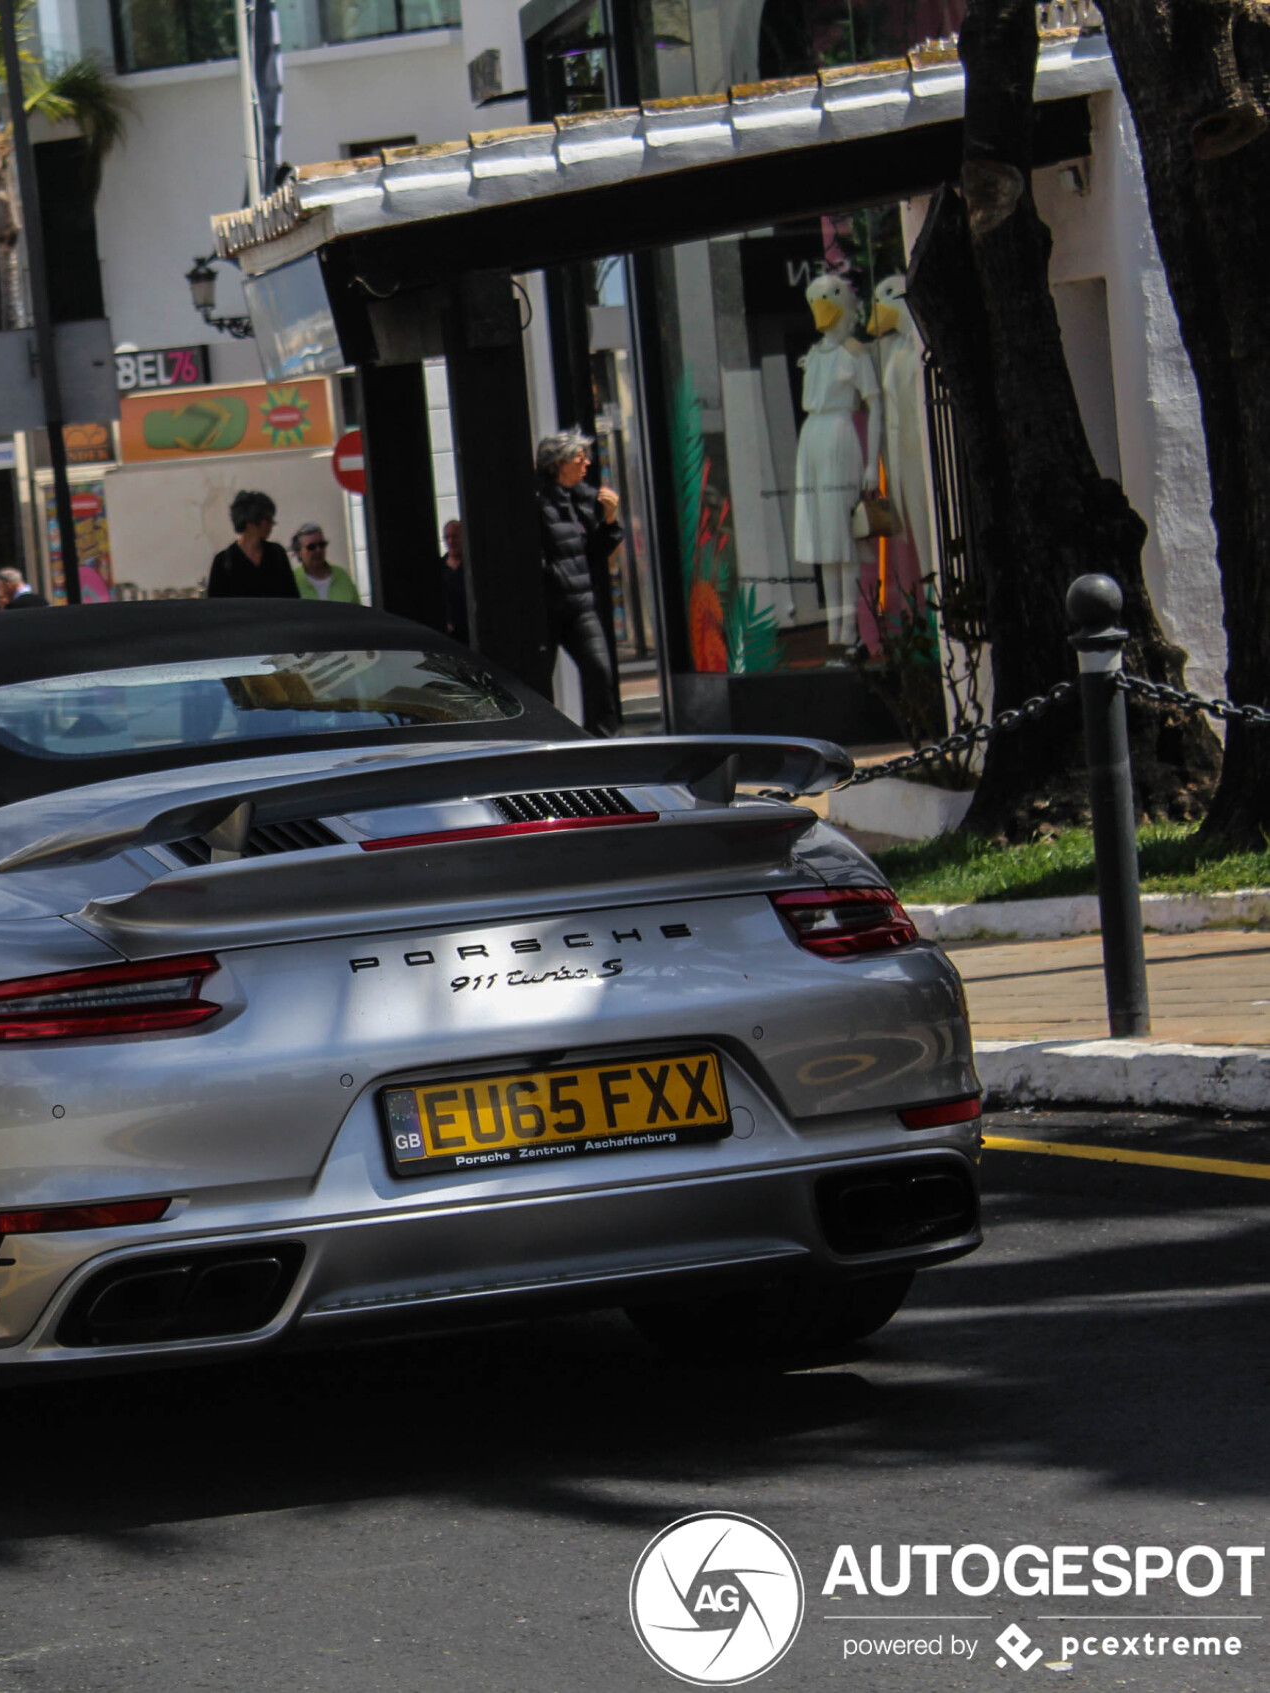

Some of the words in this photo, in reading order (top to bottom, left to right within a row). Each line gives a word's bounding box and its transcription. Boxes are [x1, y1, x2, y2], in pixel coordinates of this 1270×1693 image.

[348, 923, 692, 973] PORSCHE
[450, 974, 496, 993] 911
[597, 958, 623, 979] S
[423, 1075, 587, 1151] EU65
[597, 1060, 718, 1129] FXX
[395, 1133, 422, 1150] GB
[455, 1151, 511, 1167] Porsche
[519, 1143, 576, 1159] Zentrum
[584, 1131, 677, 1151] Aschaffenburg
